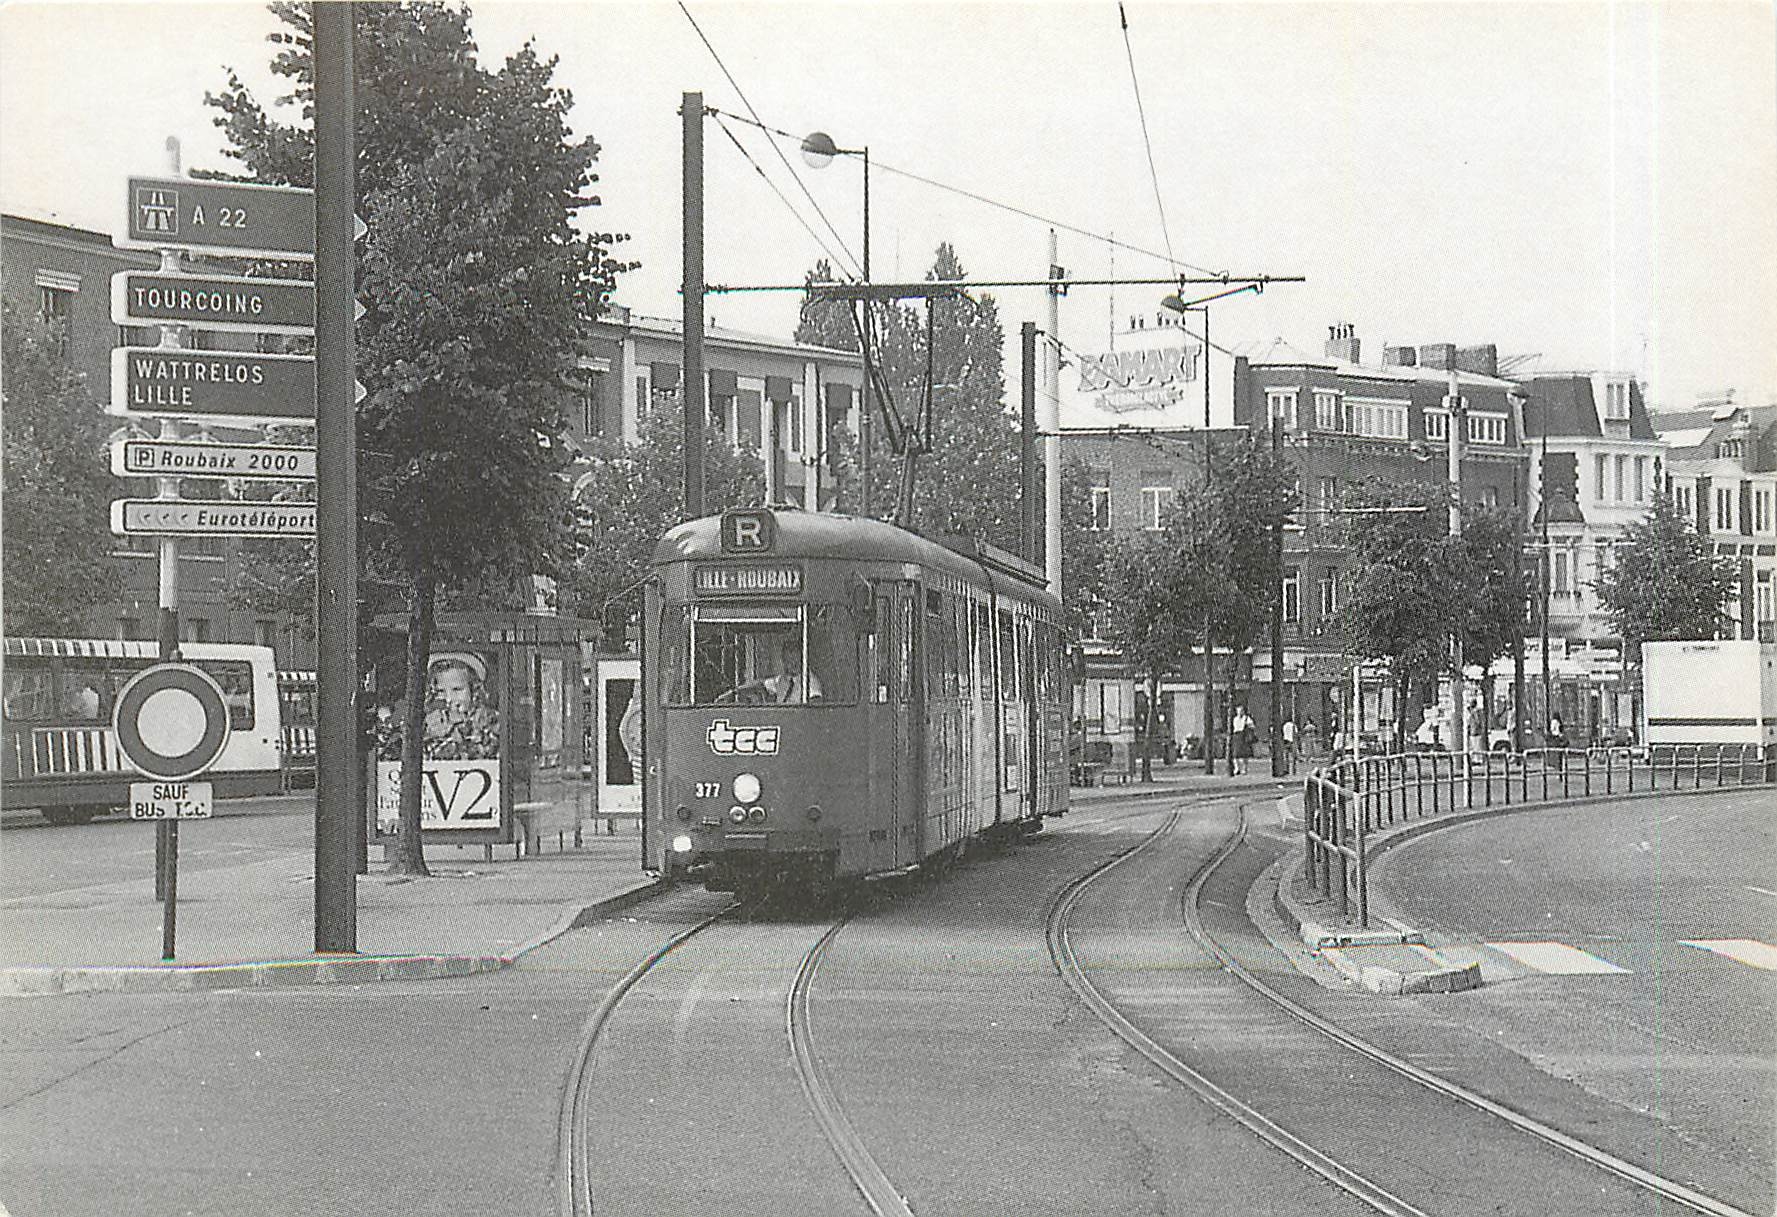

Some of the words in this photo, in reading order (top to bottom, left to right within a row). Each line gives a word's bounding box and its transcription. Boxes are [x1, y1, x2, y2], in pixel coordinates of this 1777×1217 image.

[193, 205, 205, 225] A
[219, 207, 247, 229] 22
[134, 287, 263, 314] TOURCOING
[135, 358, 264, 384] WATTRELOS
[134, 384, 193, 406] LILLE
[161, 450, 236, 469] Roubaix
[249, 453, 299, 471] 2000
[197, 509, 316, 530] Eurotéléport
[735, 517, 761, 546] R
[153, 784, 189, 800] SAUF
[695, 782, 720, 798] 377
[135, 802, 165, 817] BUS
